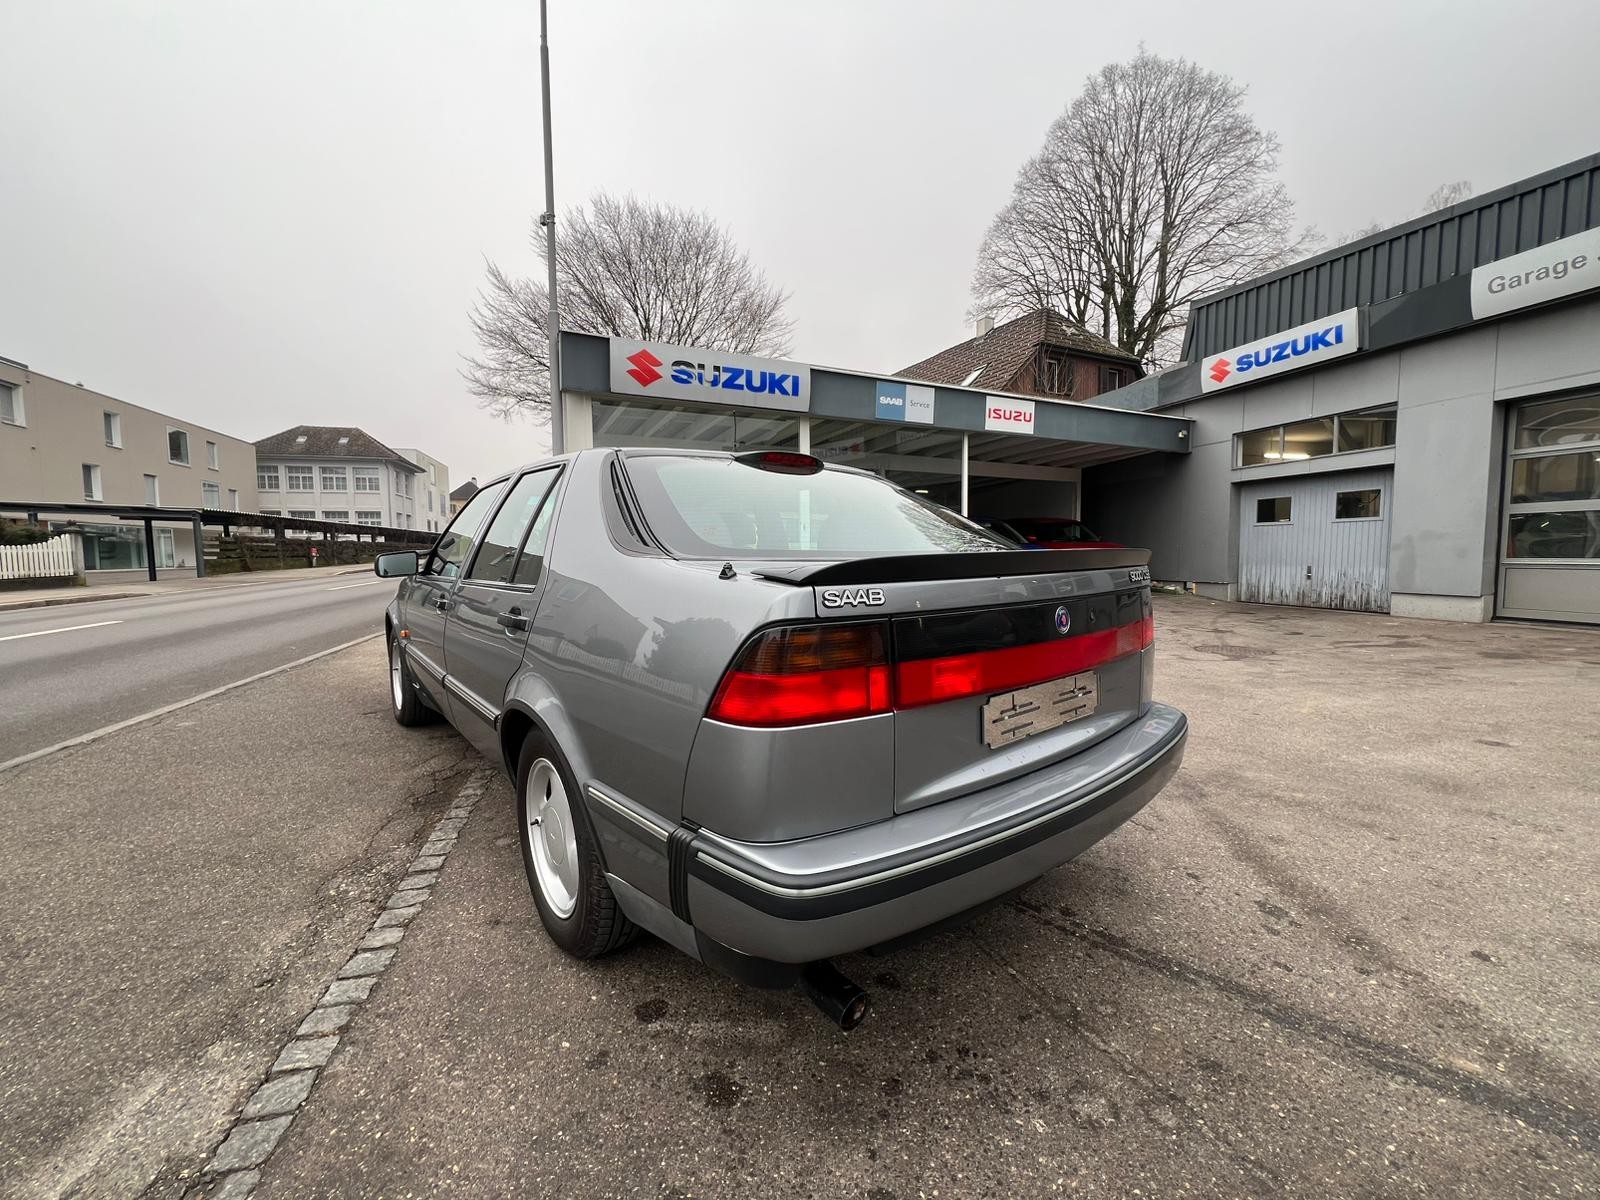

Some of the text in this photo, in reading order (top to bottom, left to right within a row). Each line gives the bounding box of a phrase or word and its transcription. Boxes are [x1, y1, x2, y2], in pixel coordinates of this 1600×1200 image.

[1487, 255, 1588, 294] Garage
[1236, 324, 1344, 373] SUZUKI
[670, 360, 800, 397] SUZUKI
[879, 396, 931, 409] SAAB Service
[988, 407, 1033, 424] ISUZU
[822, 587, 886, 609] SAAB
